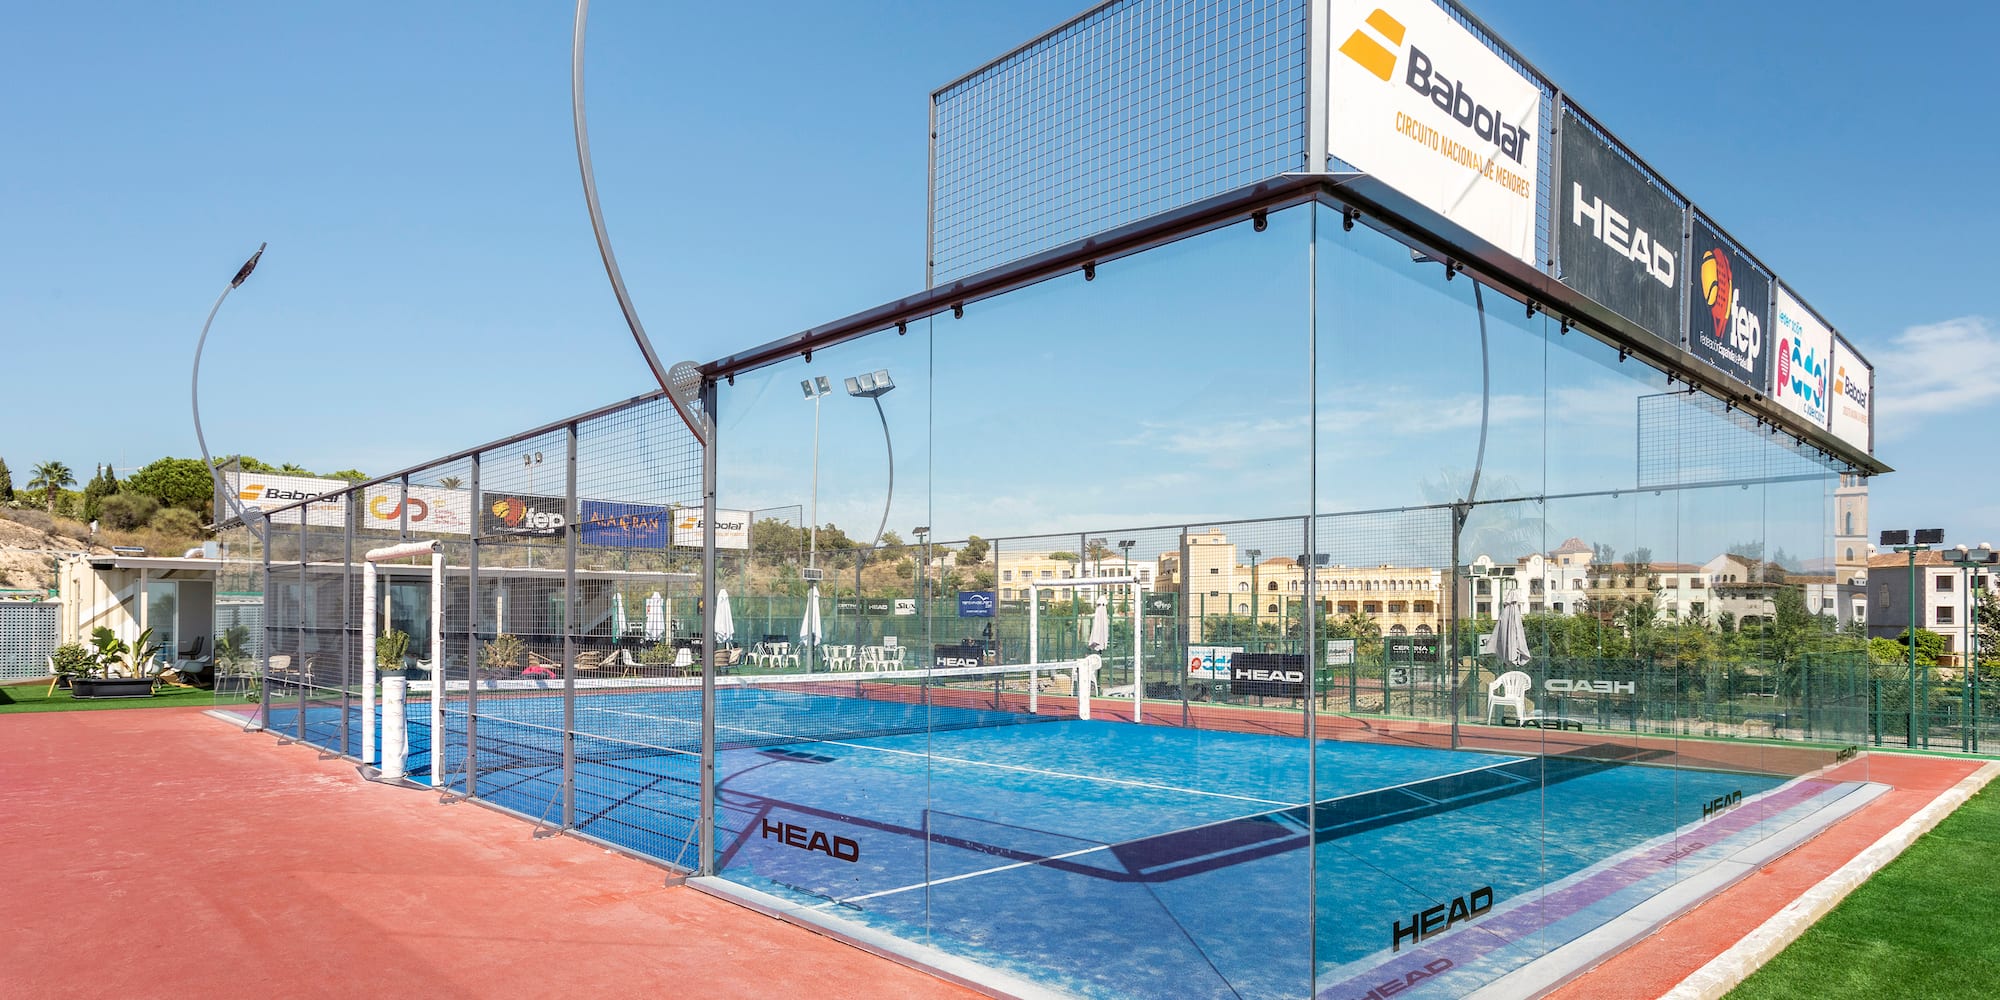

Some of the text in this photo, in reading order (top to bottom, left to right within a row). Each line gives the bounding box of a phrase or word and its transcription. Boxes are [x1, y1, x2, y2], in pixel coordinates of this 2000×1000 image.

[1395, 111, 1530, 199] CIRCUITO NACIONAL DE MENORES
[1573, 181, 1675, 289] HEAD
[1730, 288, 1761, 373] fep
[525, 507, 565, 528] fep
[936, 656, 978, 668] HEAD
[1235, 668, 1304, 683] HEAD
[1394, 668, 1408, 685] 3
[1703, 790, 1742, 823] HEAD
[762, 818, 859, 863] HEAD
[1392, 886, 1493, 953] HEAD
